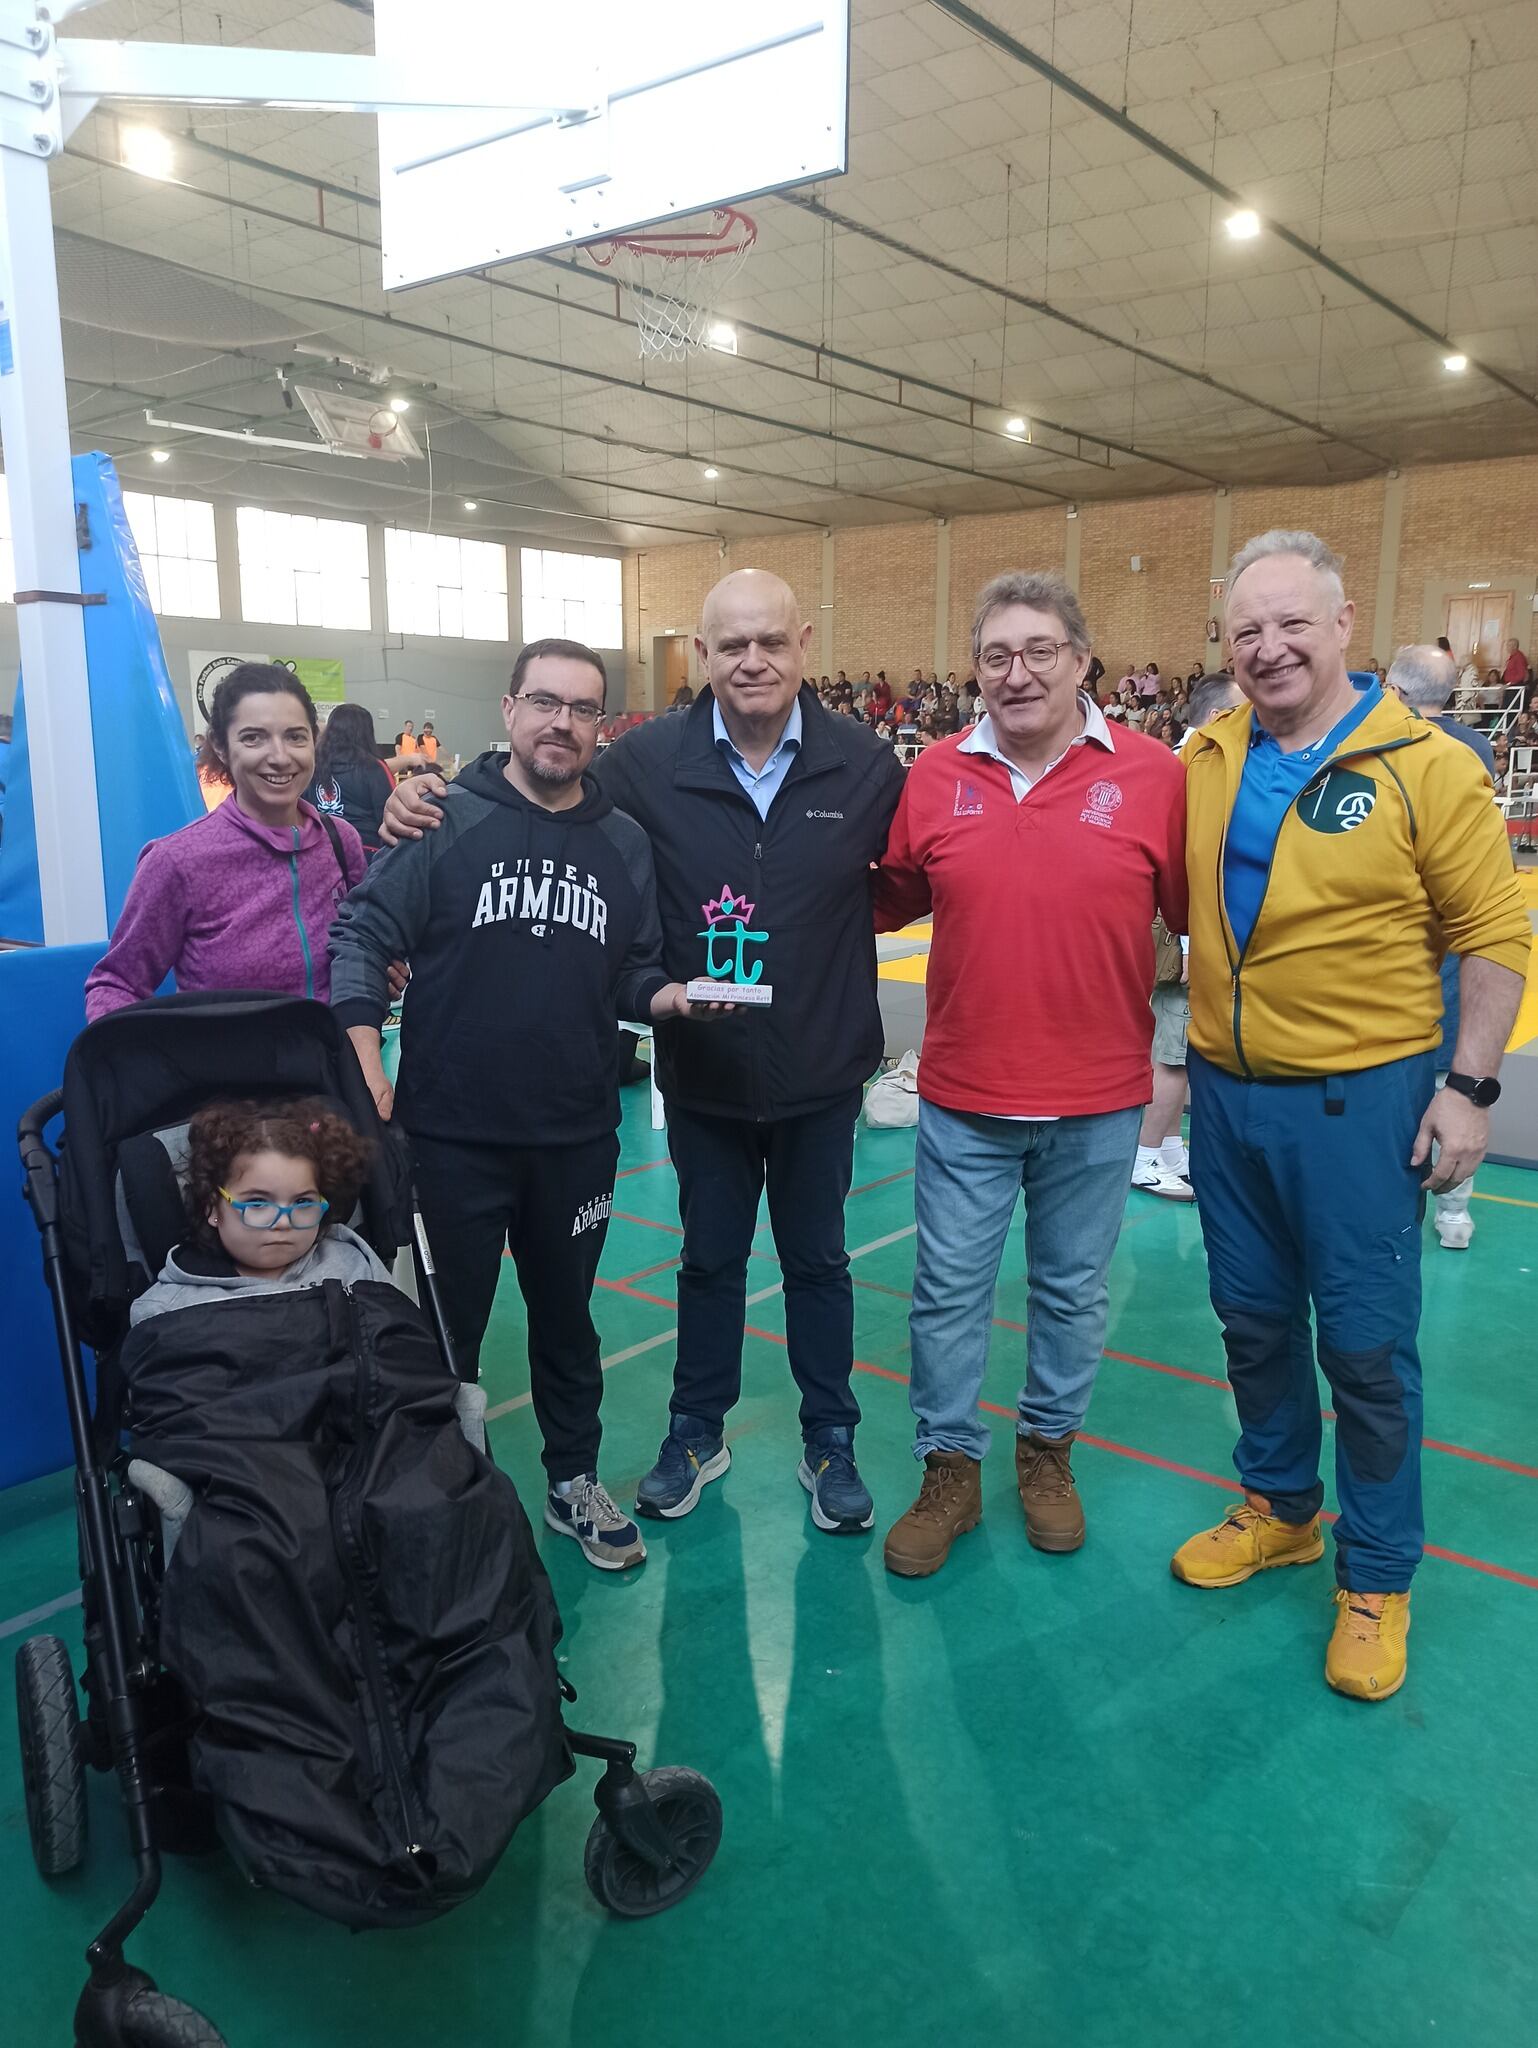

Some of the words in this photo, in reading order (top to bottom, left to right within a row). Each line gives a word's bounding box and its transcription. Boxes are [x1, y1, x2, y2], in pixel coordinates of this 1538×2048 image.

[813, 810, 844, 819] Columbia
[471, 876, 608, 946] ARMOUR
[697, 984, 724, 992] Gracias
[571, 1200, 612, 1237] ARMOU
